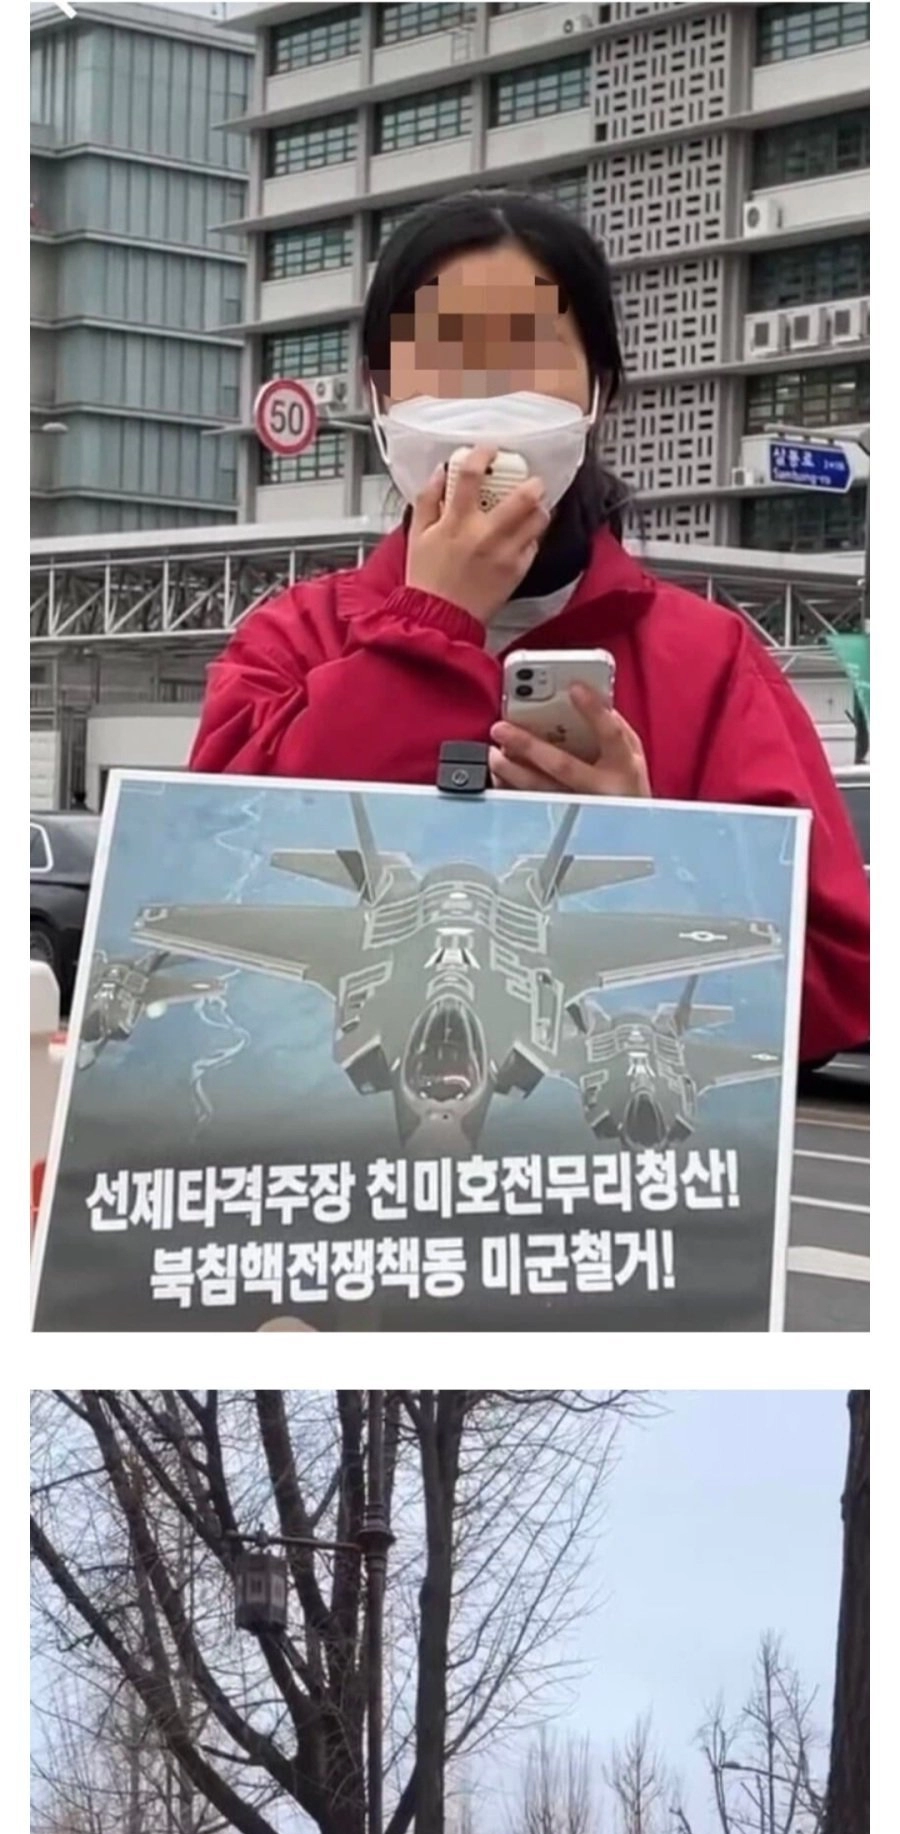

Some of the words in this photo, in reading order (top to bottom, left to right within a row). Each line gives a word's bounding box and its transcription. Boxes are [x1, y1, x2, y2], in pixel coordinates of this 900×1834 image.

[270, 399, 304, 436] 50
[86, 1161, 356, 1231] 선제타격주장
[366, 1149, 740, 1221] 친미호전무리청산!
[150, 1236, 467, 1308] 북침핵전쟁책동
[481, 1229, 675, 1295] 미군철거!
